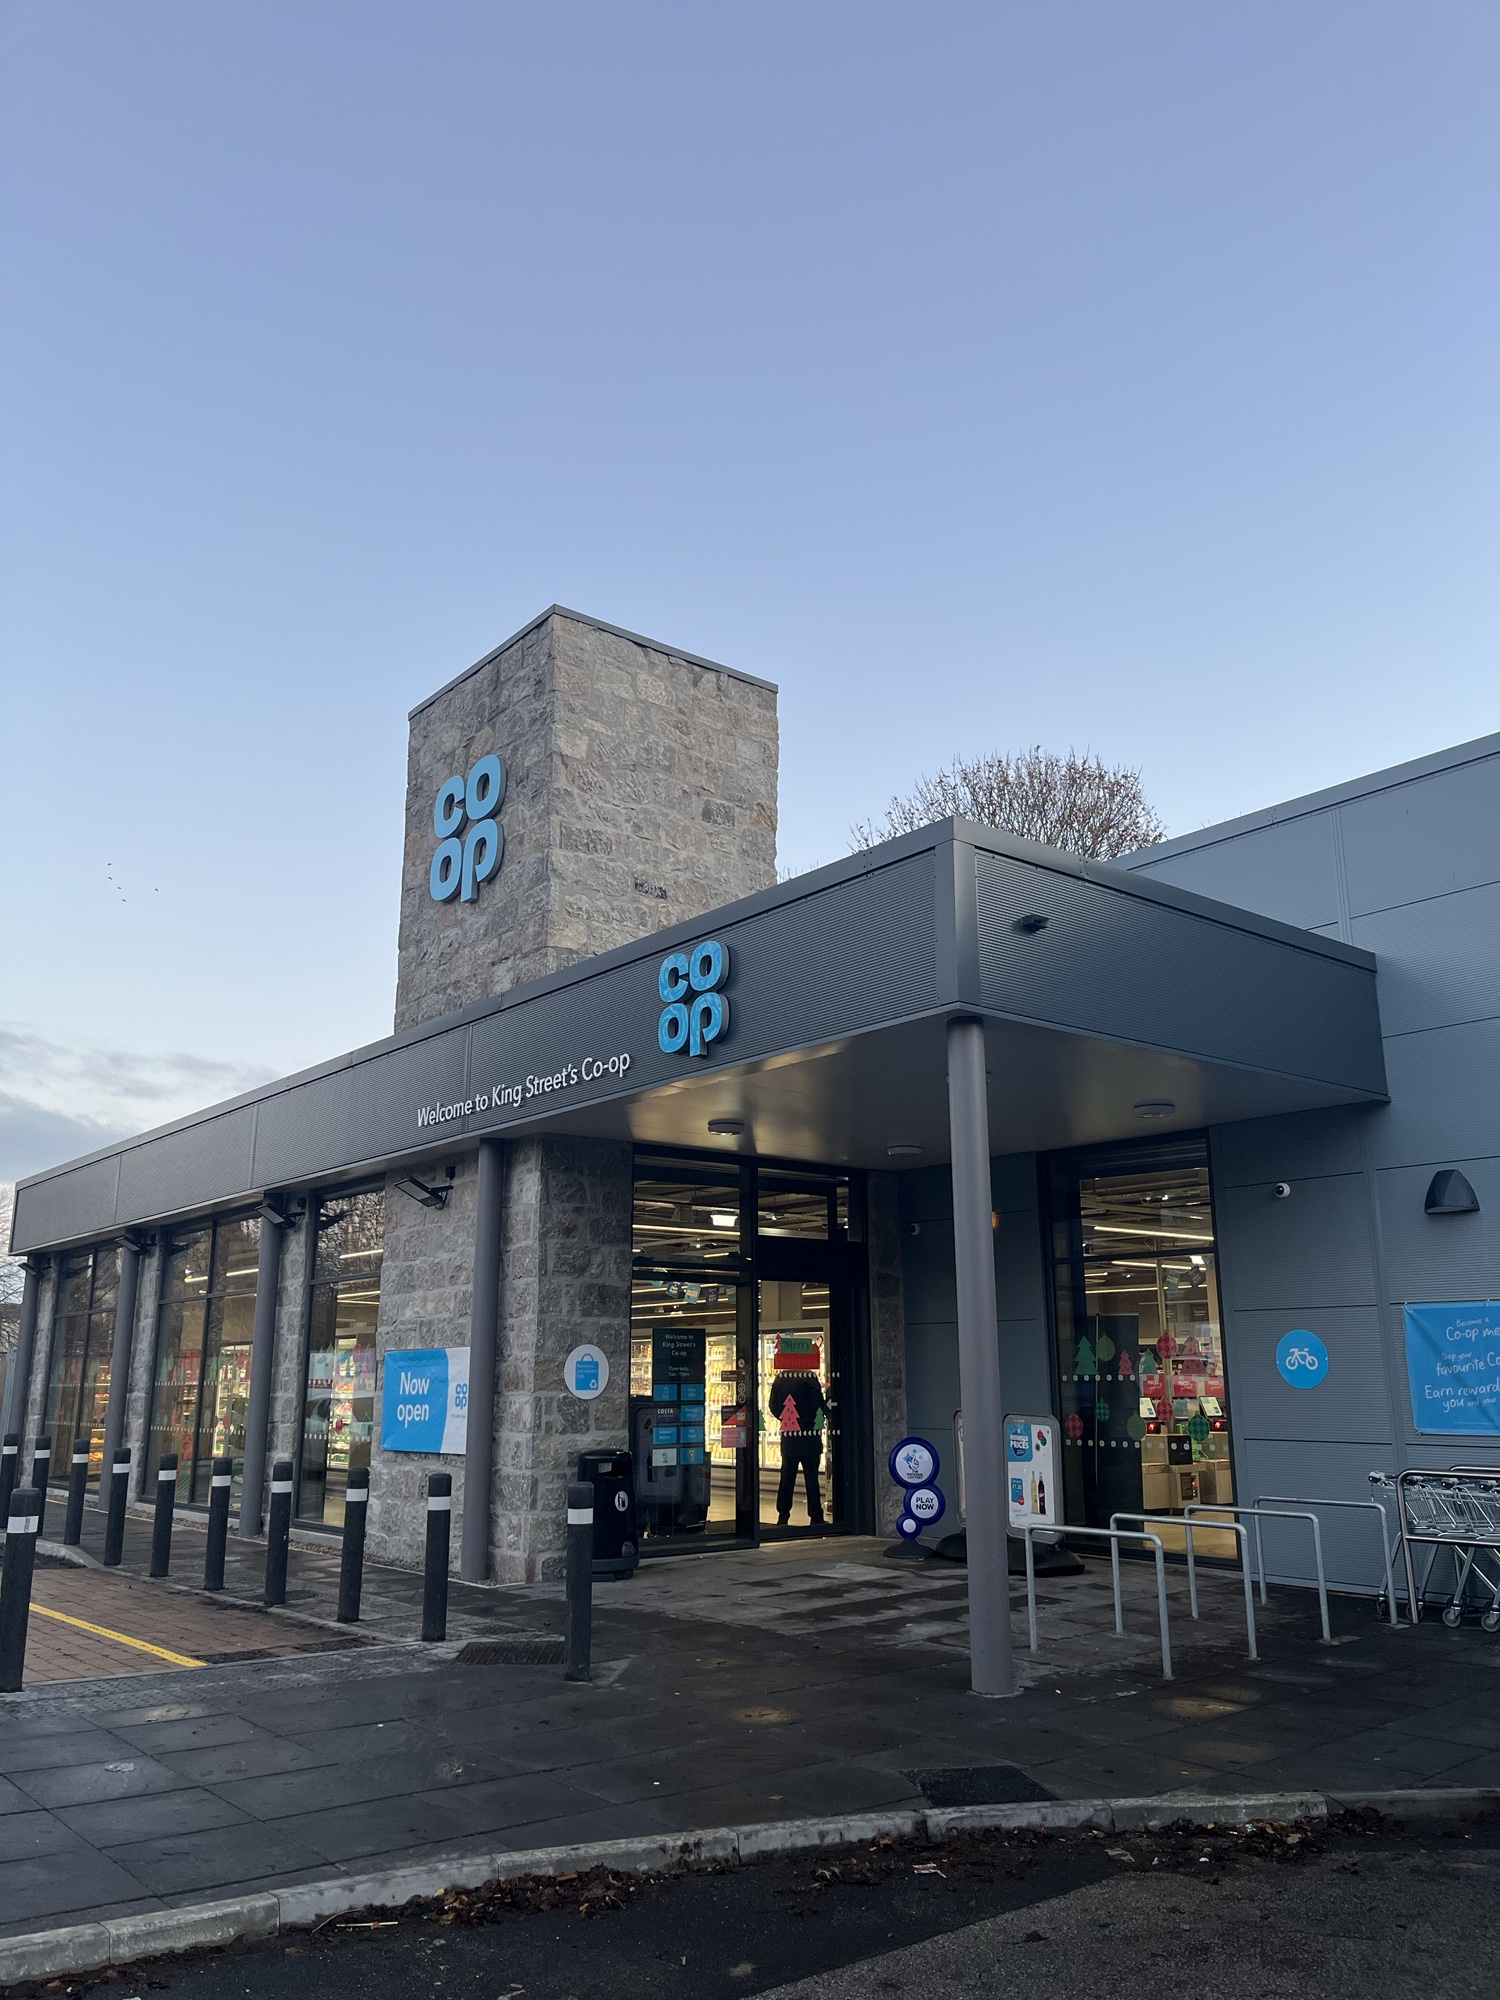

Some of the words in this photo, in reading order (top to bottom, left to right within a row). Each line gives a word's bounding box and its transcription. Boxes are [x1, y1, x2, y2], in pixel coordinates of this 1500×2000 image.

[417, 1098, 472, 1127] Welcome
[475, 1094, 488, 1111] to
[492, 1084, 522, 1107] King
[525, 1063, 578, 1098] Street's
[581, 1052, 630, 1081] Co-op
[1456, 1319, 1482, 1327] Become
[1446, 1326, 1479, 1342] Co-op
[662, 1341, 675, 1349] King
[785, 1340, 811, 1352] Merry
[776, 1355, 819, 1367] Christmas
[1457, 1352, 1473, 1361] your
[1436, 1358, 1486, 1376] favourite
[399, 1372, 430, 1395] Now
[1424, 1385, 1454, 1399] Earn
[1443, 1398, 1464, 1413] you
[1467, 1397, 1480, 1407] and
[1481, 1397, 1497, 1407] your
[397, 1403, 430, 1428] open
